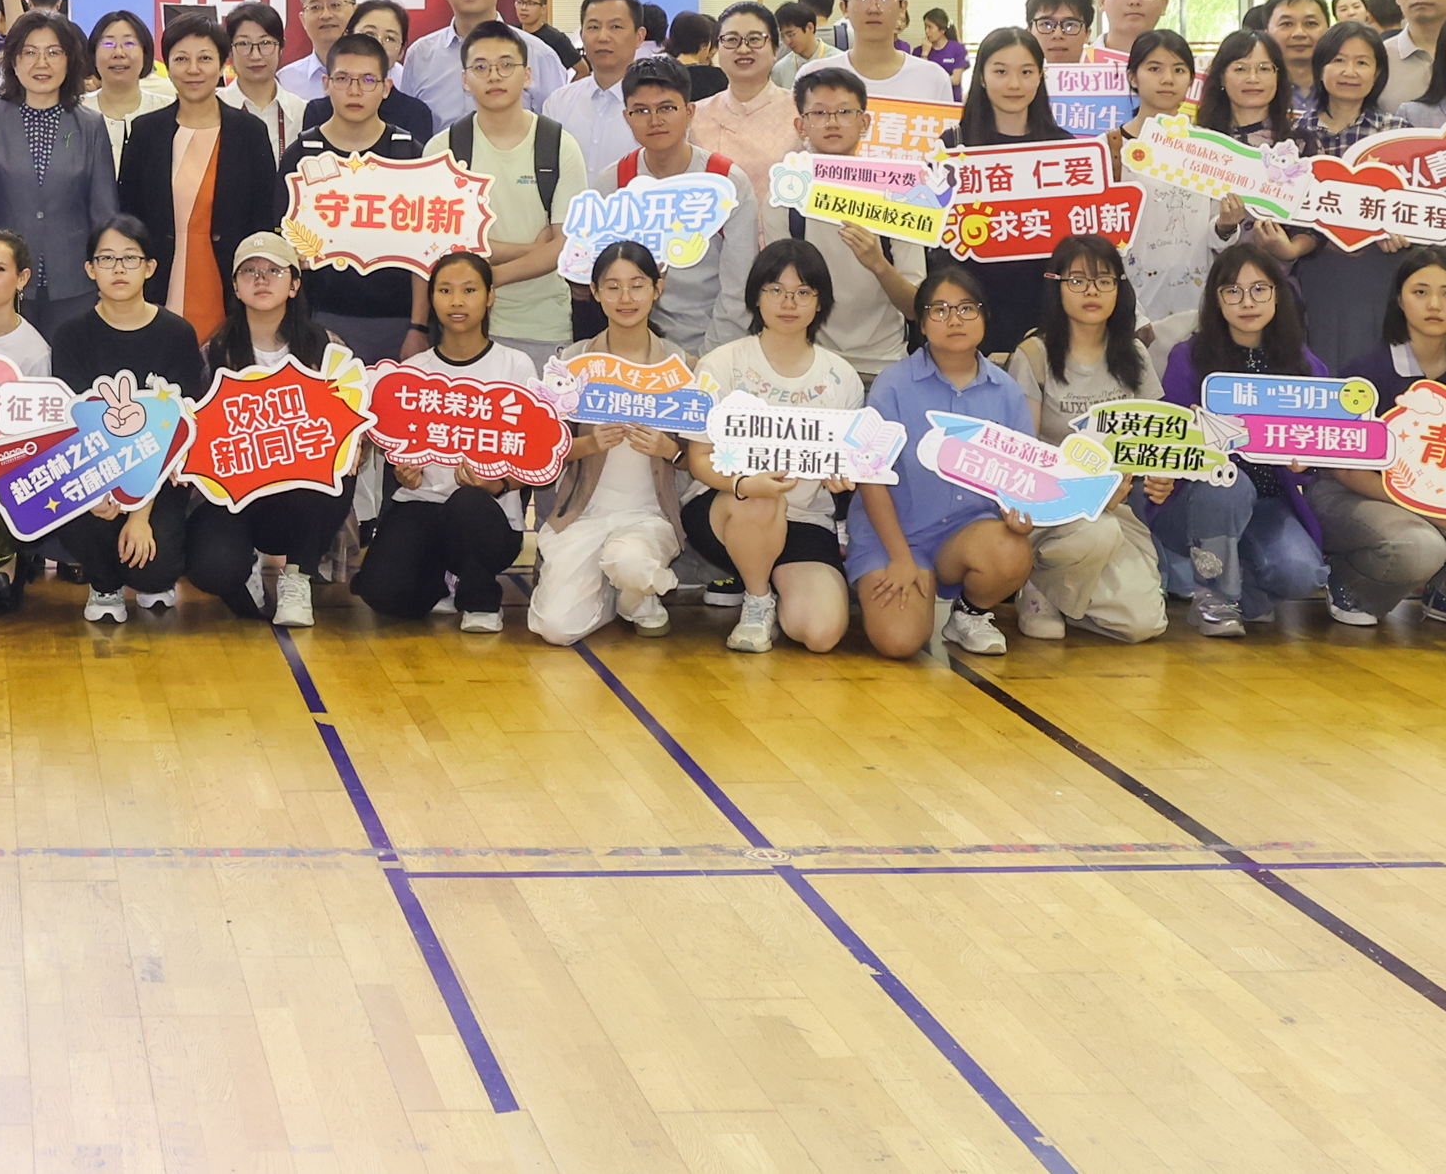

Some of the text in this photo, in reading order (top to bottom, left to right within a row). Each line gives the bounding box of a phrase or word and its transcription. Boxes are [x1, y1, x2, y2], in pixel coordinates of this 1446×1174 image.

[814, 162, 917, 188] 你的假期已欠费
[958, 156, 1094, 194] 勤奋 仁爱
[313, 189, 466, 236] 守正创新
[570, 191, 716, 231] 小小开学
[813, 191, 933, 234] 请及时返校充值
[989, 202, 1131, 242] 求实 创新
[588, 358, 684, 392] 辨人生之证
[222, 384, 309, 434] 欢迎
[394, 385, 493, 422] 七秩荣光
[584, 388, 709, 424] 立鸿鹄之志
[425, 422, 526, 457] 笃行日新
[1096, 408, 1188, 442] 岐黄有约
[1264, 423, 1368, 453] 开学报到
[61, 430, 162, 504] 守康健之诺
[210, 419, 337, 478] 新同学
[746, 446, 848, 476] 最佳新生
[1071, 442, 1107, 474] UP!
[1114, 441, 1206, 472] 医路有你
[8, 429, 111, 507] 赴杏林之约
[954, 448, 1039, 502] 启航处
